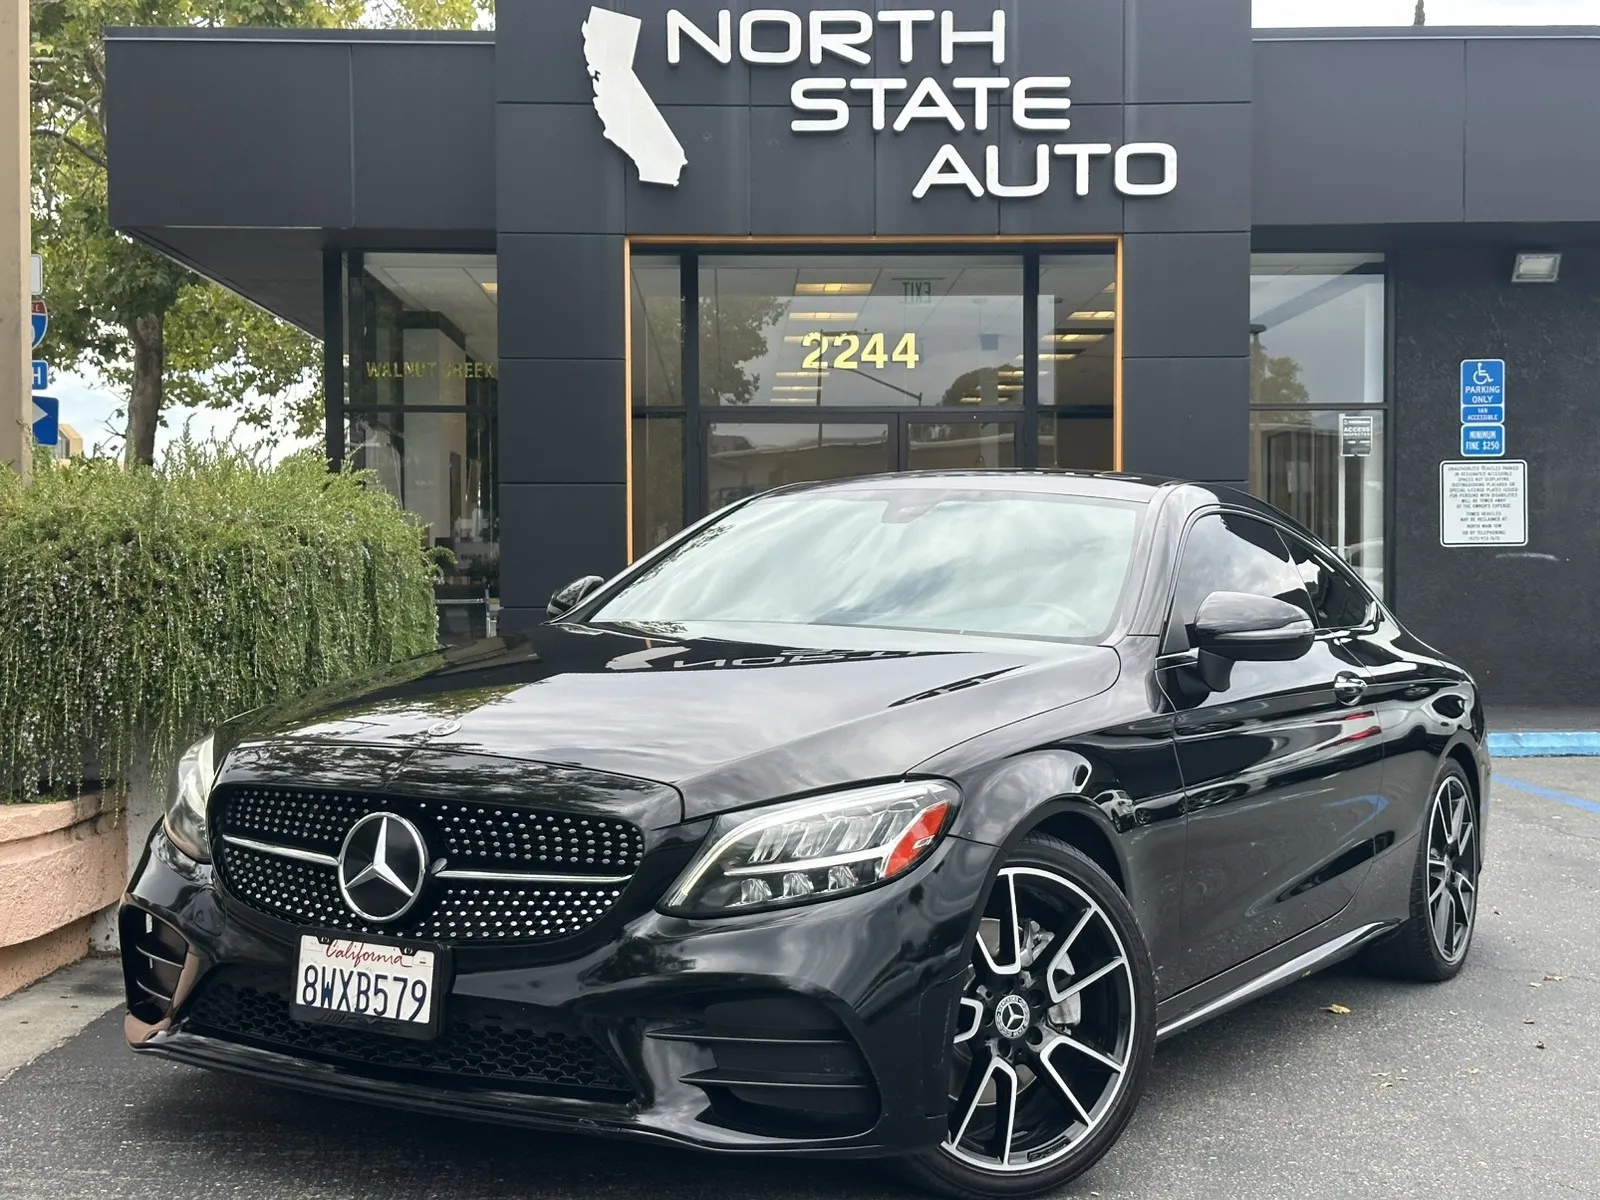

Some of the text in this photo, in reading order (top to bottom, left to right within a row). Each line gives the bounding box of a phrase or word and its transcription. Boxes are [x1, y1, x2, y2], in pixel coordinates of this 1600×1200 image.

[667, 9, 1006, 66] NORTH
[790, 76, 1073, 133] STATE
[912, 142, 1178, 199] AUTO
[801, 331, 920, 369] 2244
[366, 361, 437, 378] WALNUT
[1465, 385, 1501, 394] PARKING
[1471, 395, 1494, 404] ONLY
[1465, 441, 1500, 451] FINE $250
[1469, 430, 1497, 440] MINIMUM
[325, 940, 412, 968] California
[302, 964, 427, 1022] 8WXB579
